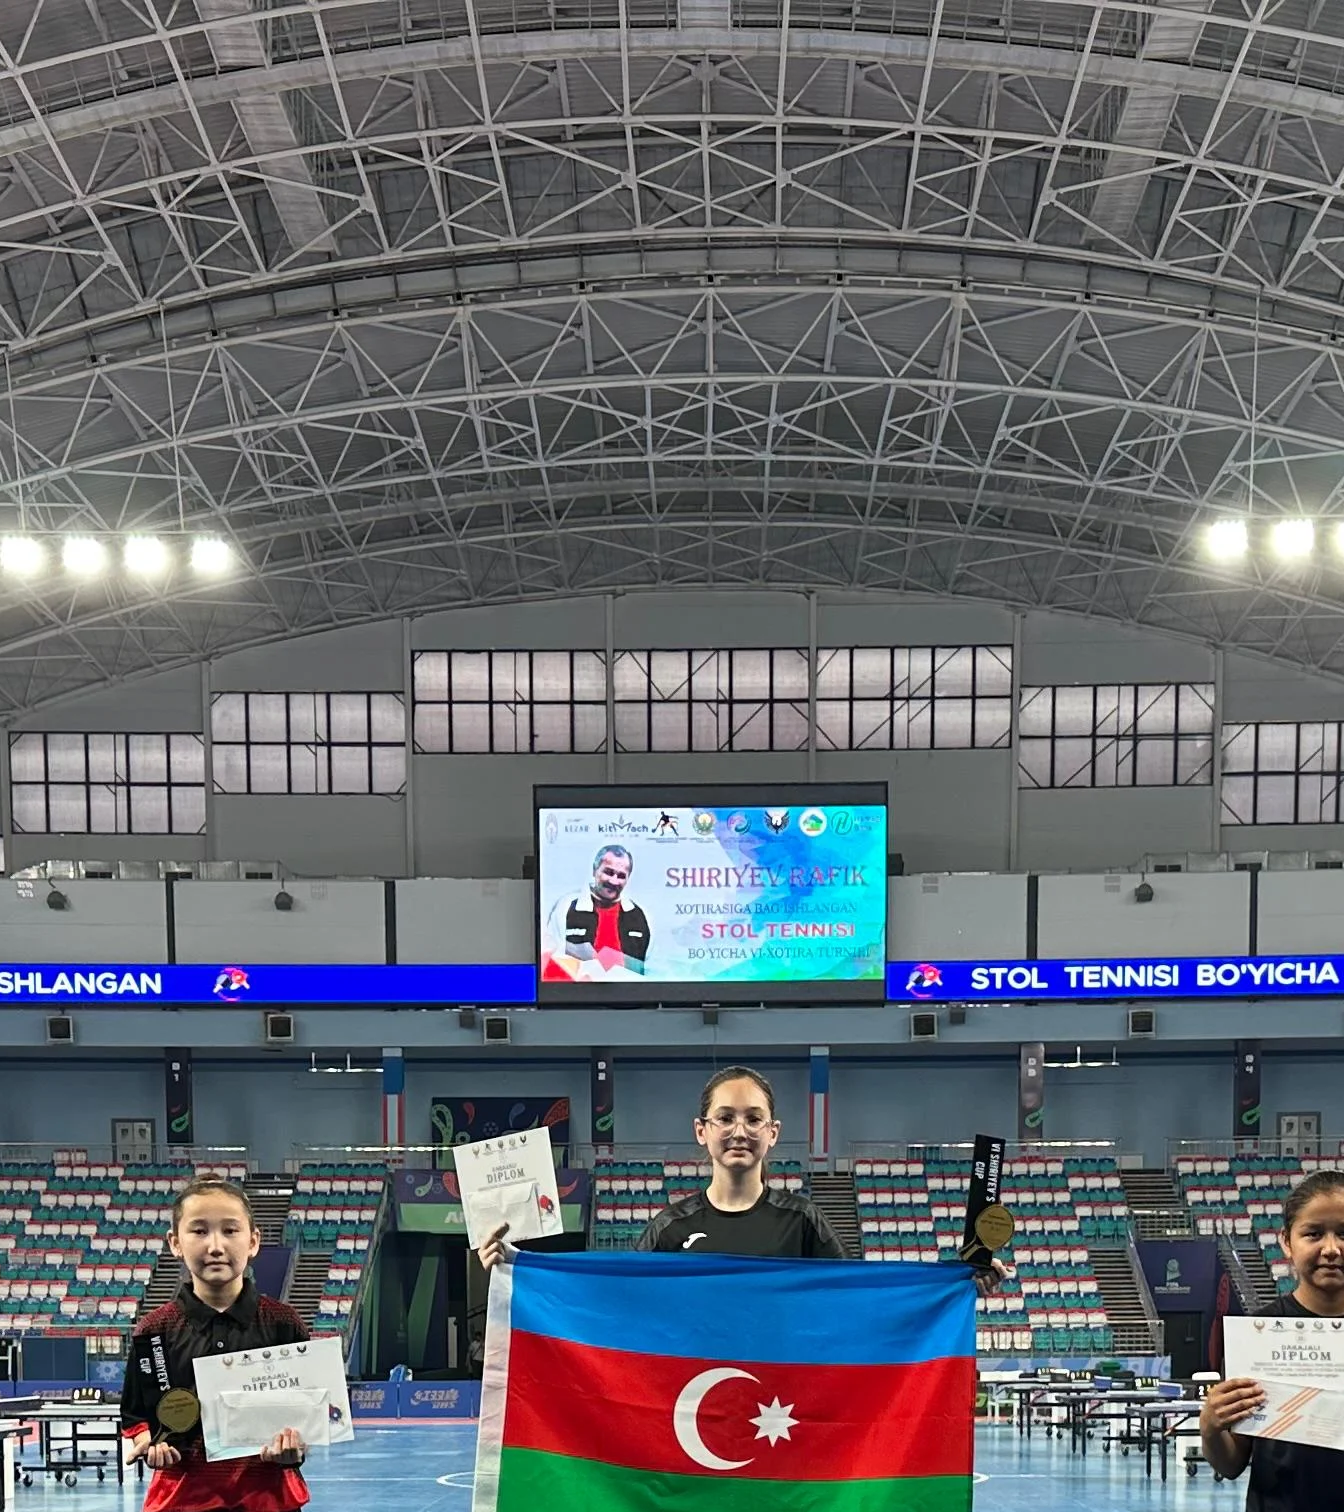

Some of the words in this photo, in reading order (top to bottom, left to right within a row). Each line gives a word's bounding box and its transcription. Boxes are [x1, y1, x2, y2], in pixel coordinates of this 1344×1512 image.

[665, 864, 782, 888] SHIRIYEV
[790, 865, 870, 888] RAFIK
[675, 903, 752, 915] XOTIRASIGA
[701, 923, 759, 939] STOL
[766, 922, 856, 938] TENNISI
[971, 966, 1048, 990] STOL
[1064, 964, 1180, 988] TENNISI
[1197, 961, 1339, 987] BO'YICHA
[486, 1168, 526, 1184] DIPLOM
[975, 1161, 985, 1180] CUP
[1271, 1351, 1332, 1361] DIPLOM
[139, 1357, 152, 1374] CUP
[242, 1377, 300, 1391] DIPLOM
